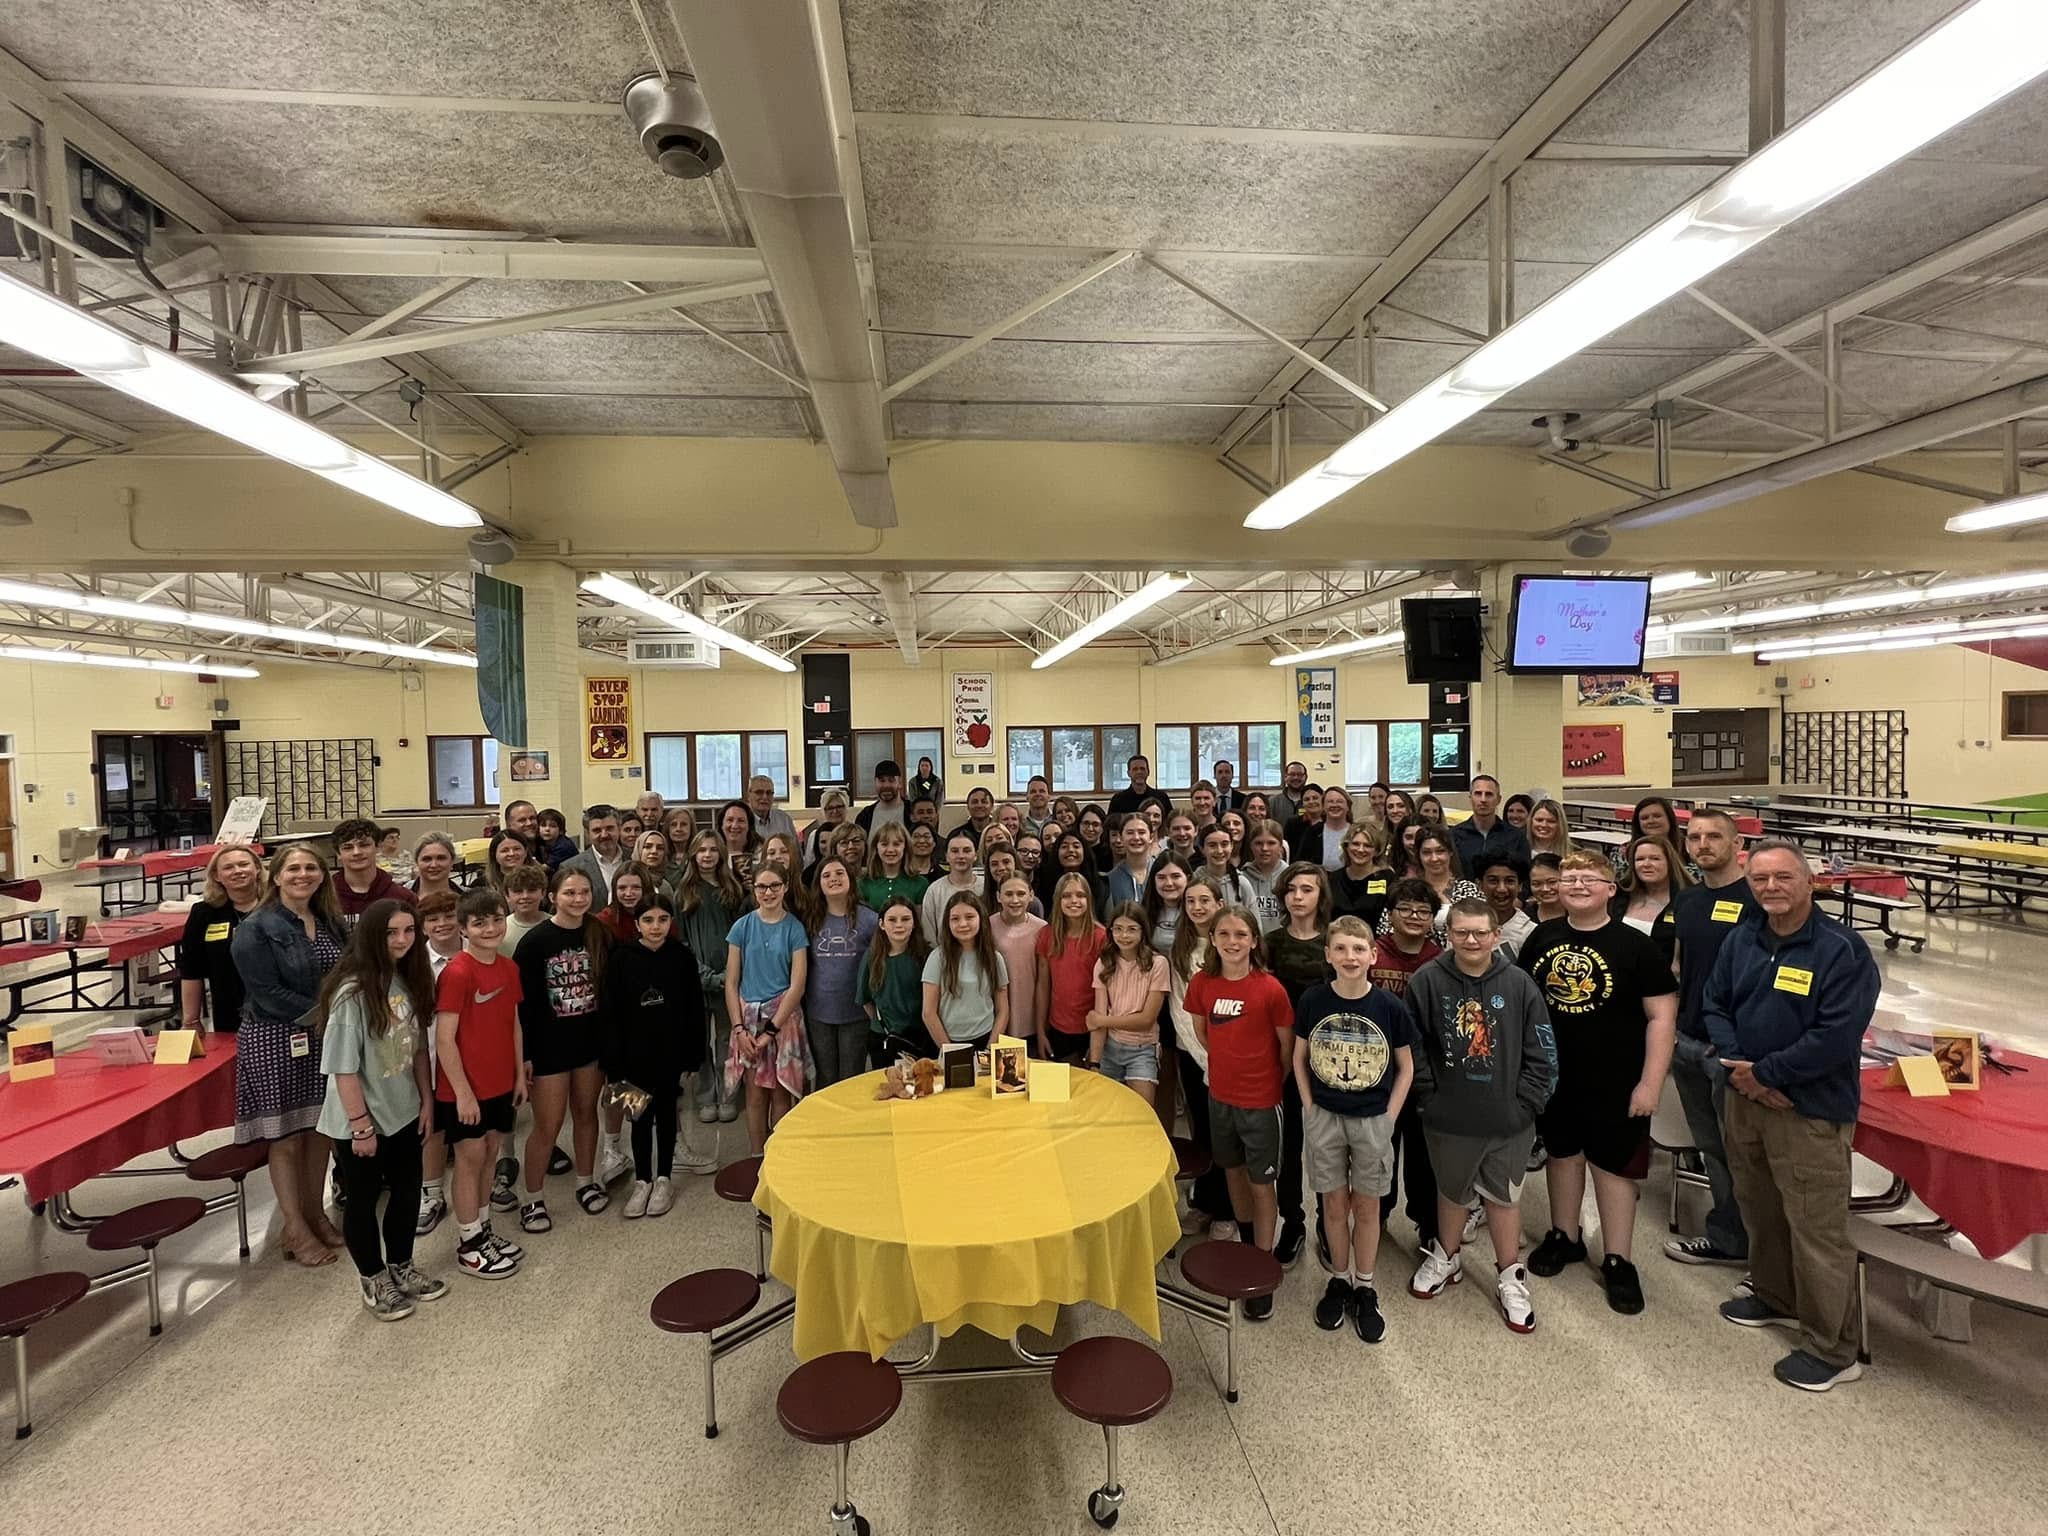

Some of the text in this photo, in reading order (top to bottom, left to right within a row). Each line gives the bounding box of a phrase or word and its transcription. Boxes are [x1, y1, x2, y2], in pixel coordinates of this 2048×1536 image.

[1569, 614, 1594, 632] Day
[589, 681, 628, 692] NEVER
[593, 693, 624, 706] STOP
[590, 707, 628, 724] LEARNING!
[1315, 713, 1331, 722] Acts
[1319, 724, 1327, 733] of
[1602, 973, 1613, 998] HARD
[1213, 998, 1245, 1016] NIKE
[1558, 1003, 1595, 1014] MERCY
[1348, 1045, 1385, 1056] BEACH
